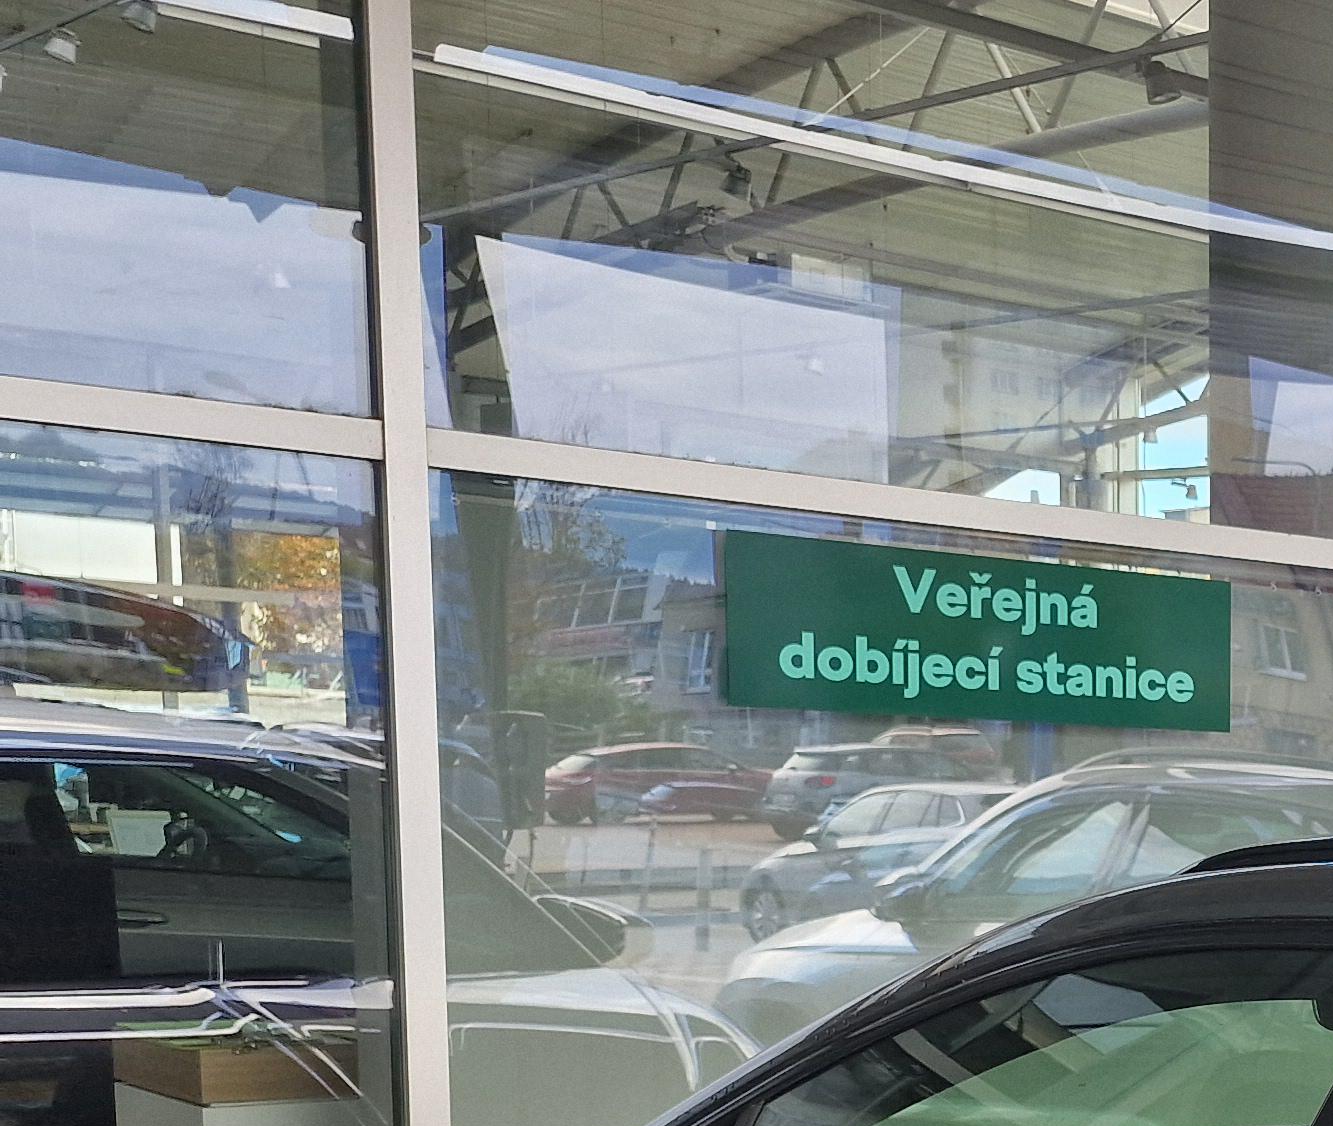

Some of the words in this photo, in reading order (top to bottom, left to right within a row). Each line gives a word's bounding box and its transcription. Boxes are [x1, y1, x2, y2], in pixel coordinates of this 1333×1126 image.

[893, 565, 1099, 636] Veřejná
[778, 631, 1001, 699] dobíjecí
[1016, 652, 1195, 703] stanice
